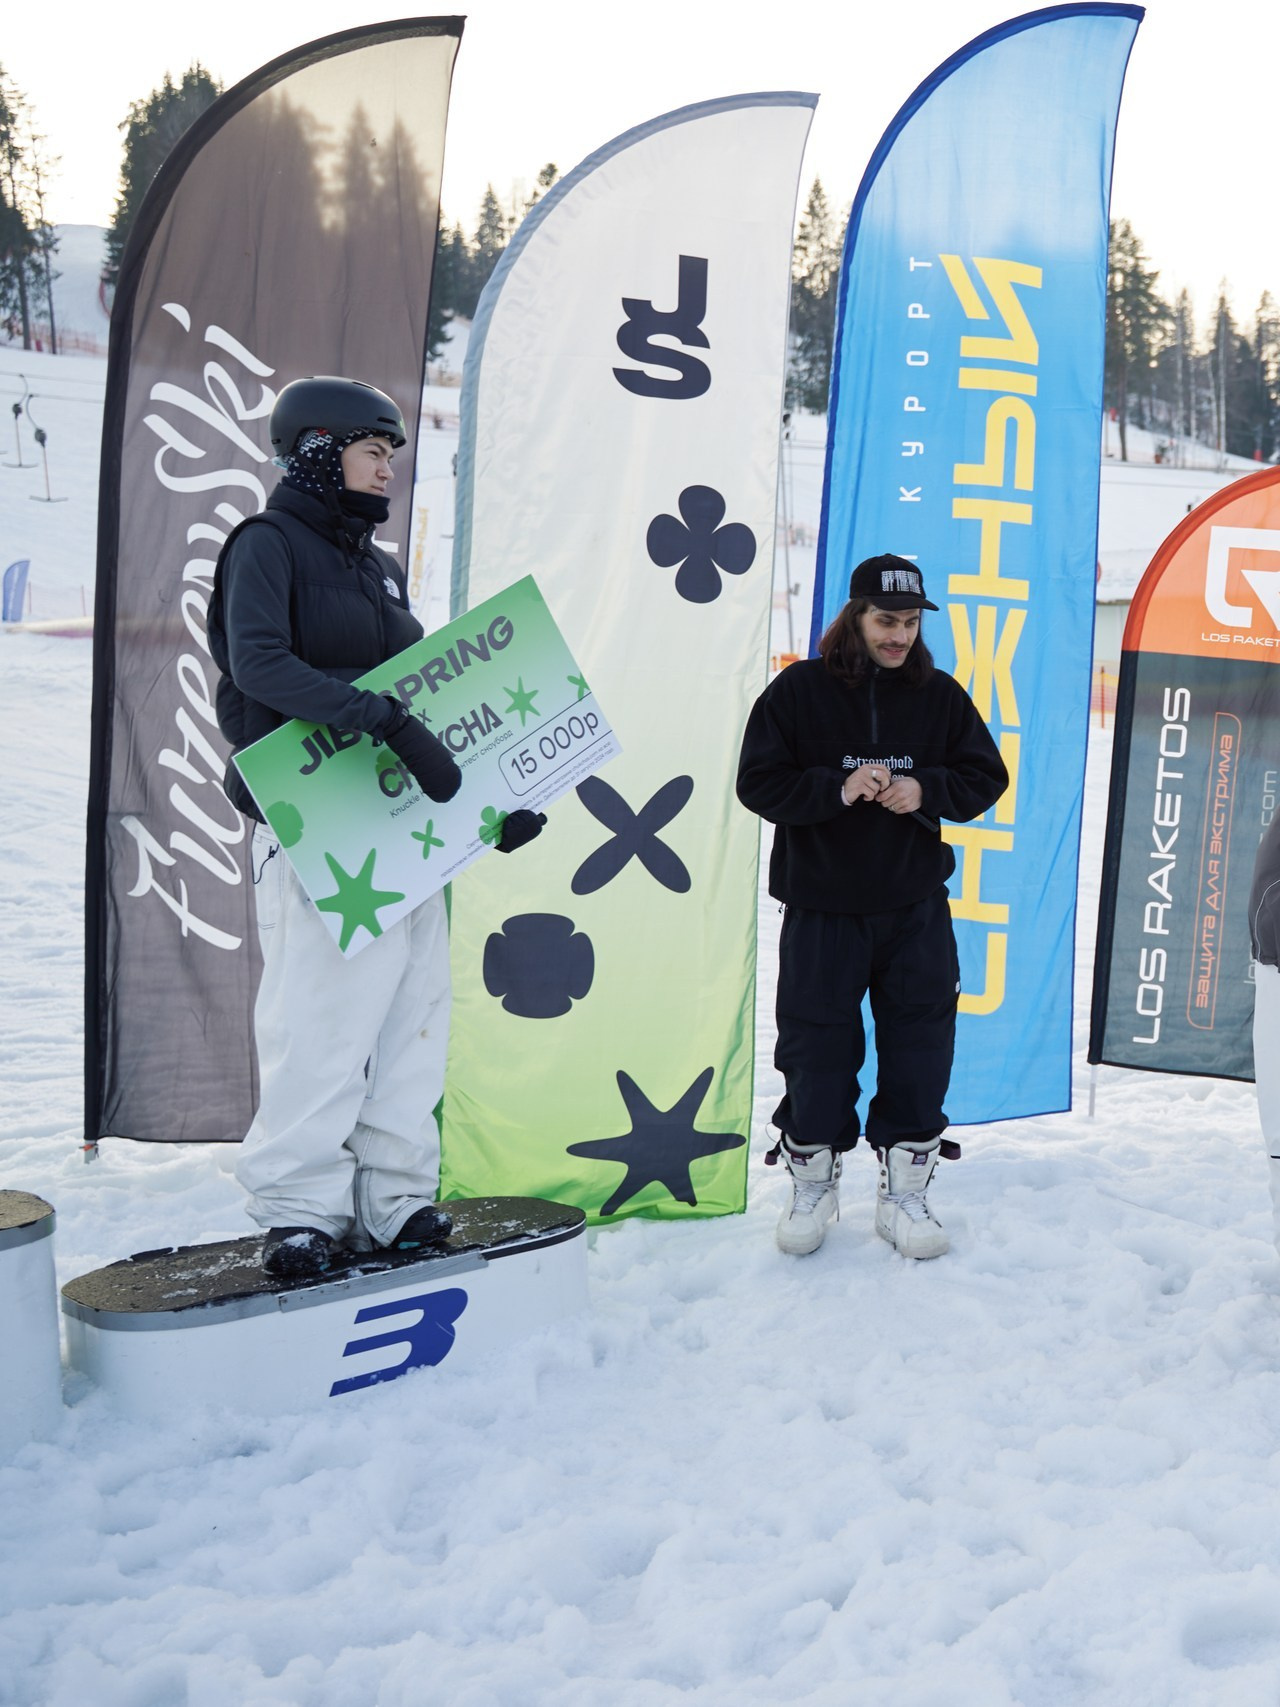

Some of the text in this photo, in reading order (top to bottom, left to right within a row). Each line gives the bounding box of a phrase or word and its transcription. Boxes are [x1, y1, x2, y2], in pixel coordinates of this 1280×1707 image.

[1201, 632, 1231, 643] LOS
[379, 615, 515, 710] PRING
[481, 729, 514, 756] сноуборд
[511, 748, 538, 780] 15
[389, 796, 421, 818] Knuckle
[1132, 687, 1191, 1045] LOS RAKETOS
